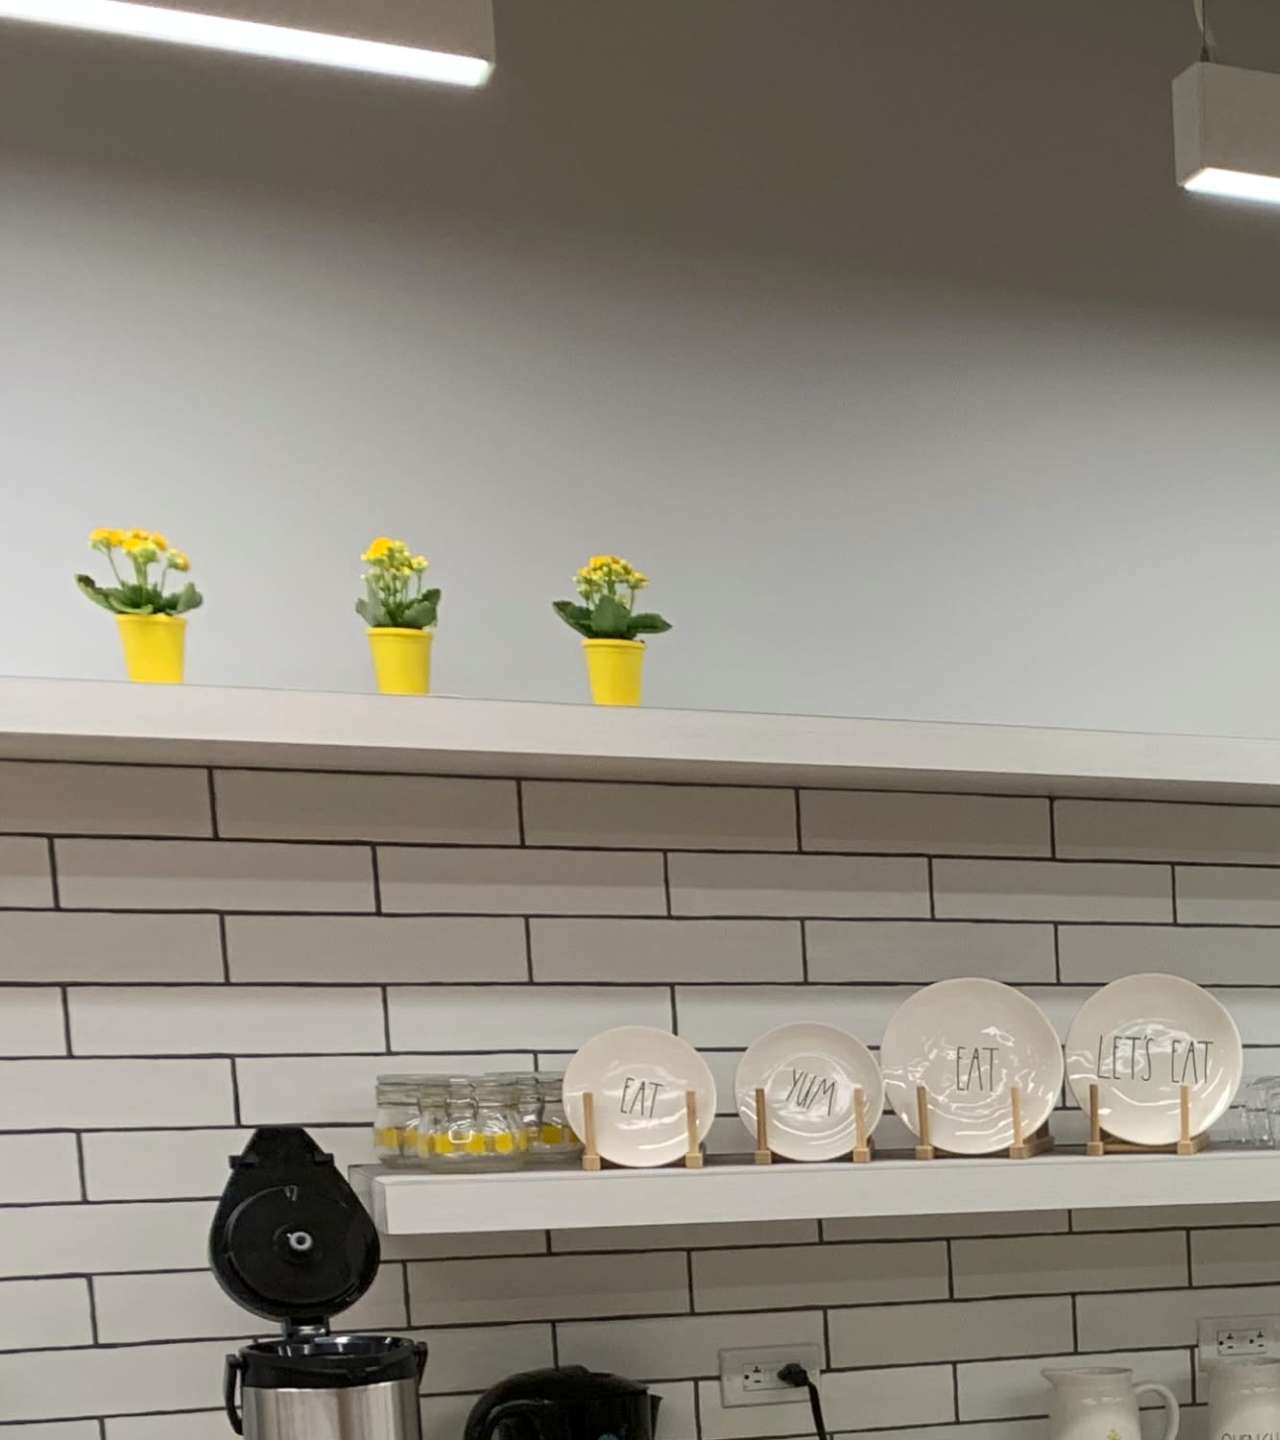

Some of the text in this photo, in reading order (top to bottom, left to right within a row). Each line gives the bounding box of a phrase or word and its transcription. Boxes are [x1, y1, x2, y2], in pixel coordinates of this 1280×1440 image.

[956, 1046, 999, 1091] EAT
[1097, 1035, 1214, 1084] LET'S EAT
[620, 1077, 664, 1119] EAT
[786, 1068, 837, 1117] YUM
